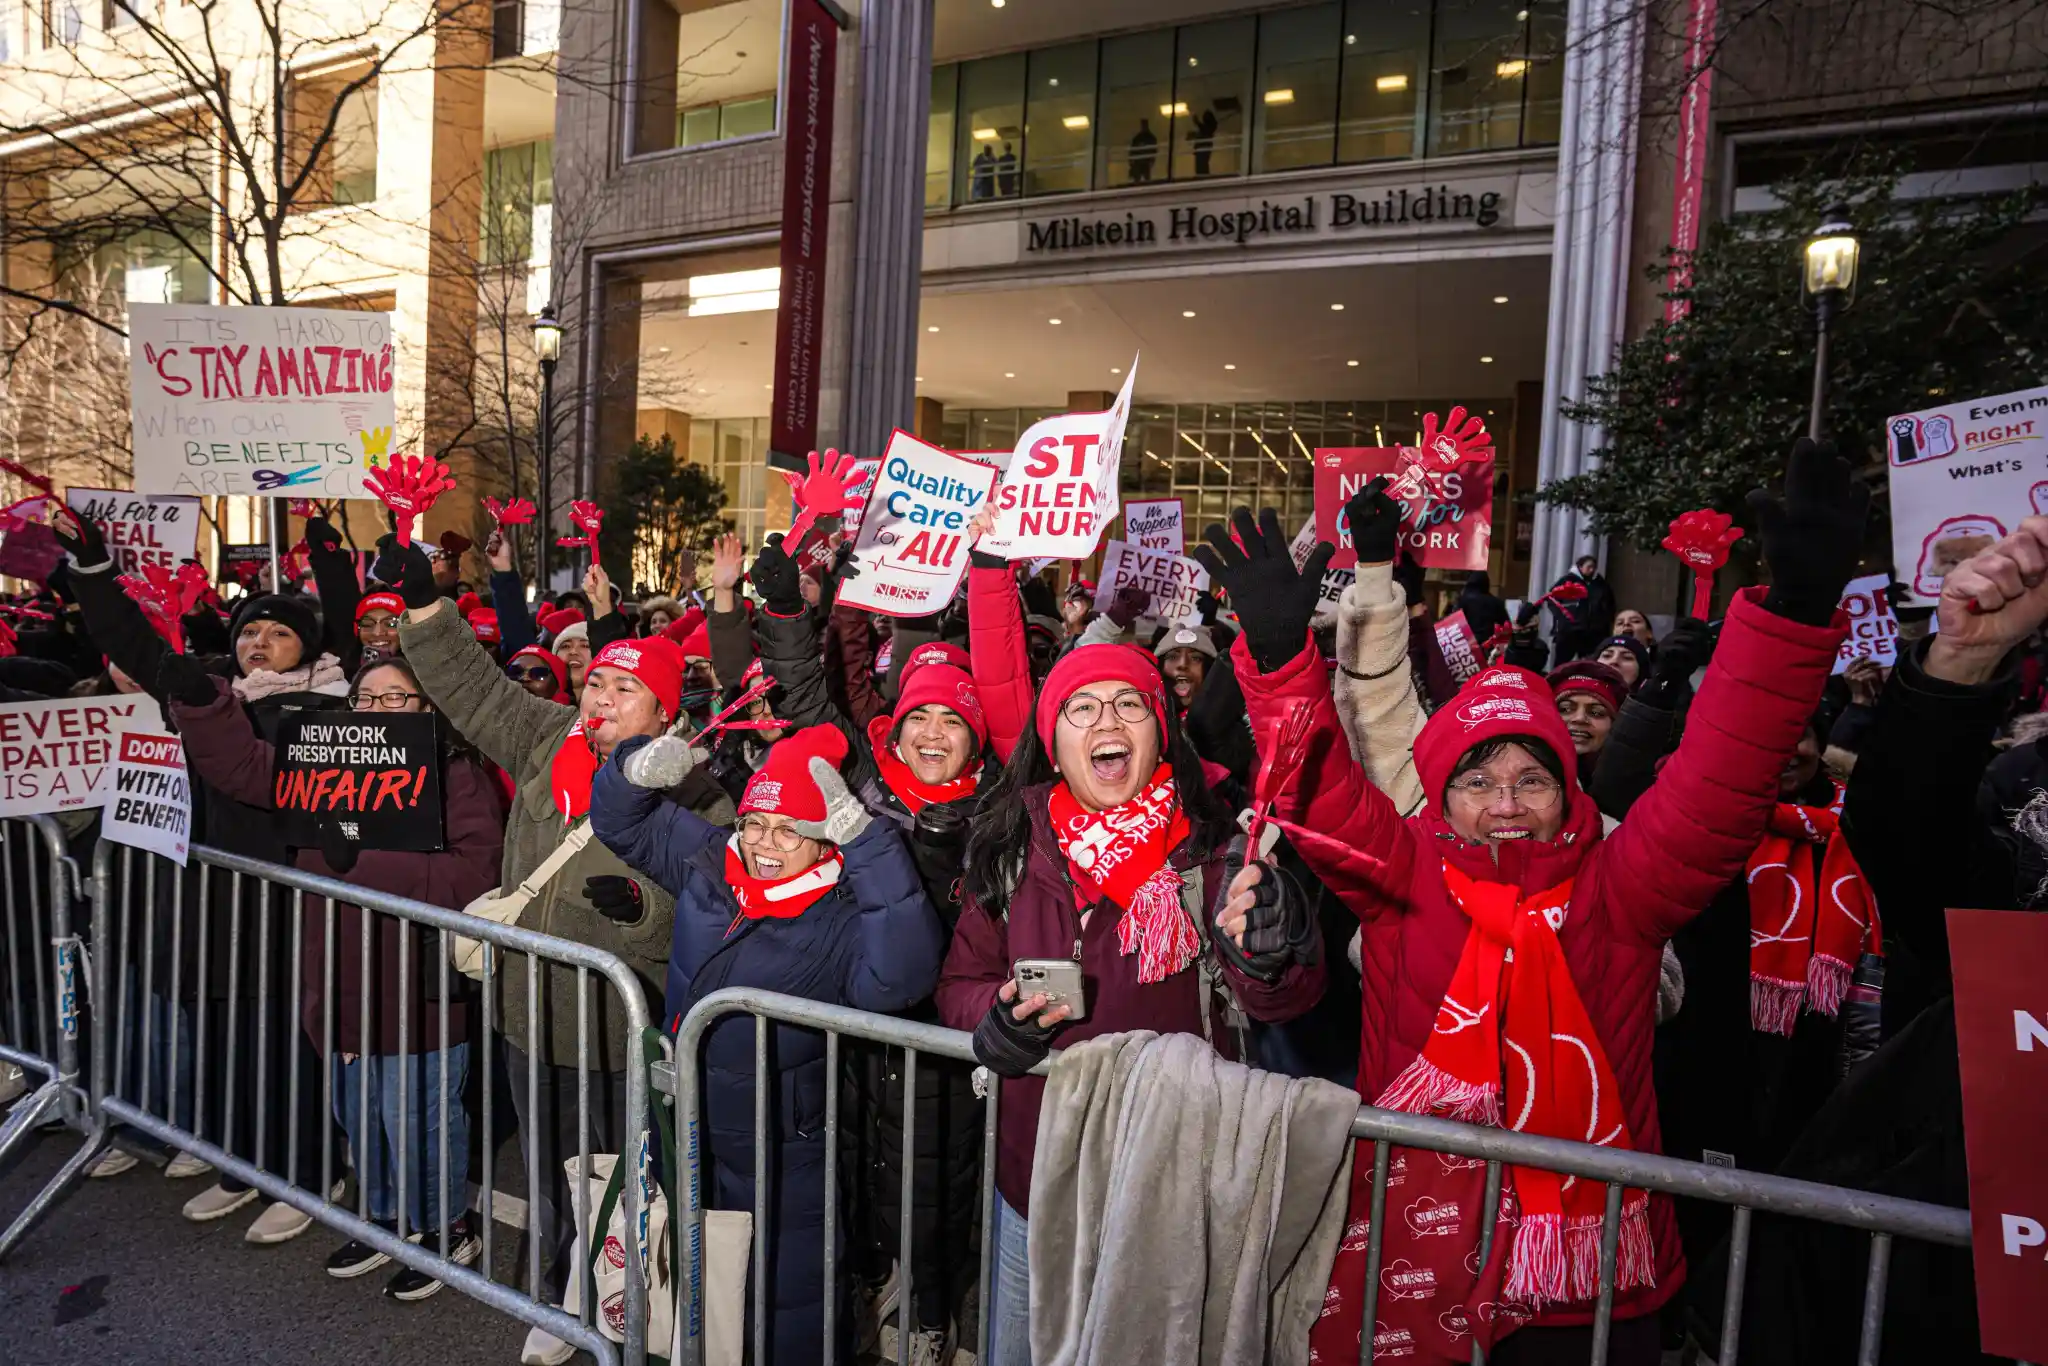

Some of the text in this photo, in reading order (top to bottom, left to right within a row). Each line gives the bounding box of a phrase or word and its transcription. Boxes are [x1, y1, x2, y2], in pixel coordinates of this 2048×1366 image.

[1026, 184, 1502, 252] Milstein Hospital Building
[163, 315, 384, 346] ITS HARD TO
[785, 263, 804, 432] Irving Medical Center
[795, 270, 815, 429] Columbia University
[137, 404, 216, 438] When
[1969, 401, 2025, 420] Even
[1964, 420, 2036, 446] RIGHT
[184, 441, 354, 466] BENEFITS
[1024, 434, 1100, 478] ST
[172, 468, 367, 497] ARE CU
[887, 457, 985, 508] Quality
[1948, 459, 2023, 480] What's
[82, 497, 118, 522] Ask
[162, 504, 181, 523] a
[887, 490, 963, 530] Care
[1128, 511, 1179, 535] Support
[1146, 506, 1162, 519] We
[1414, 498, 1464, 532] for
[872, 524, 962, 568] for All
[1140, 537, 1170, 550] NYP
[1119, 549, 1200, 584] EVERY
[873, 582, 932, 601] NURSES
[1114, 570, 1199, 604] PATIENT
[1156, 598, 1192, 619] VIP
[300, 724, 387, 744] NEW YORK
[287, 744, 407, 765] PRESBYTERIAN
[4, 773, 39, 800] IS
[48, 771, 70, 797] A
[117, 768, 171, 798] WITH
[275, 765, 428, 813] UNFAIR!
[114, 797, 188, 836] BENEFITS
[1091, 840, 1133, 885] State
[1414, 1204, 1460, 1224] NURSES
[1390, 1271, 1436, 1286] NURSES
